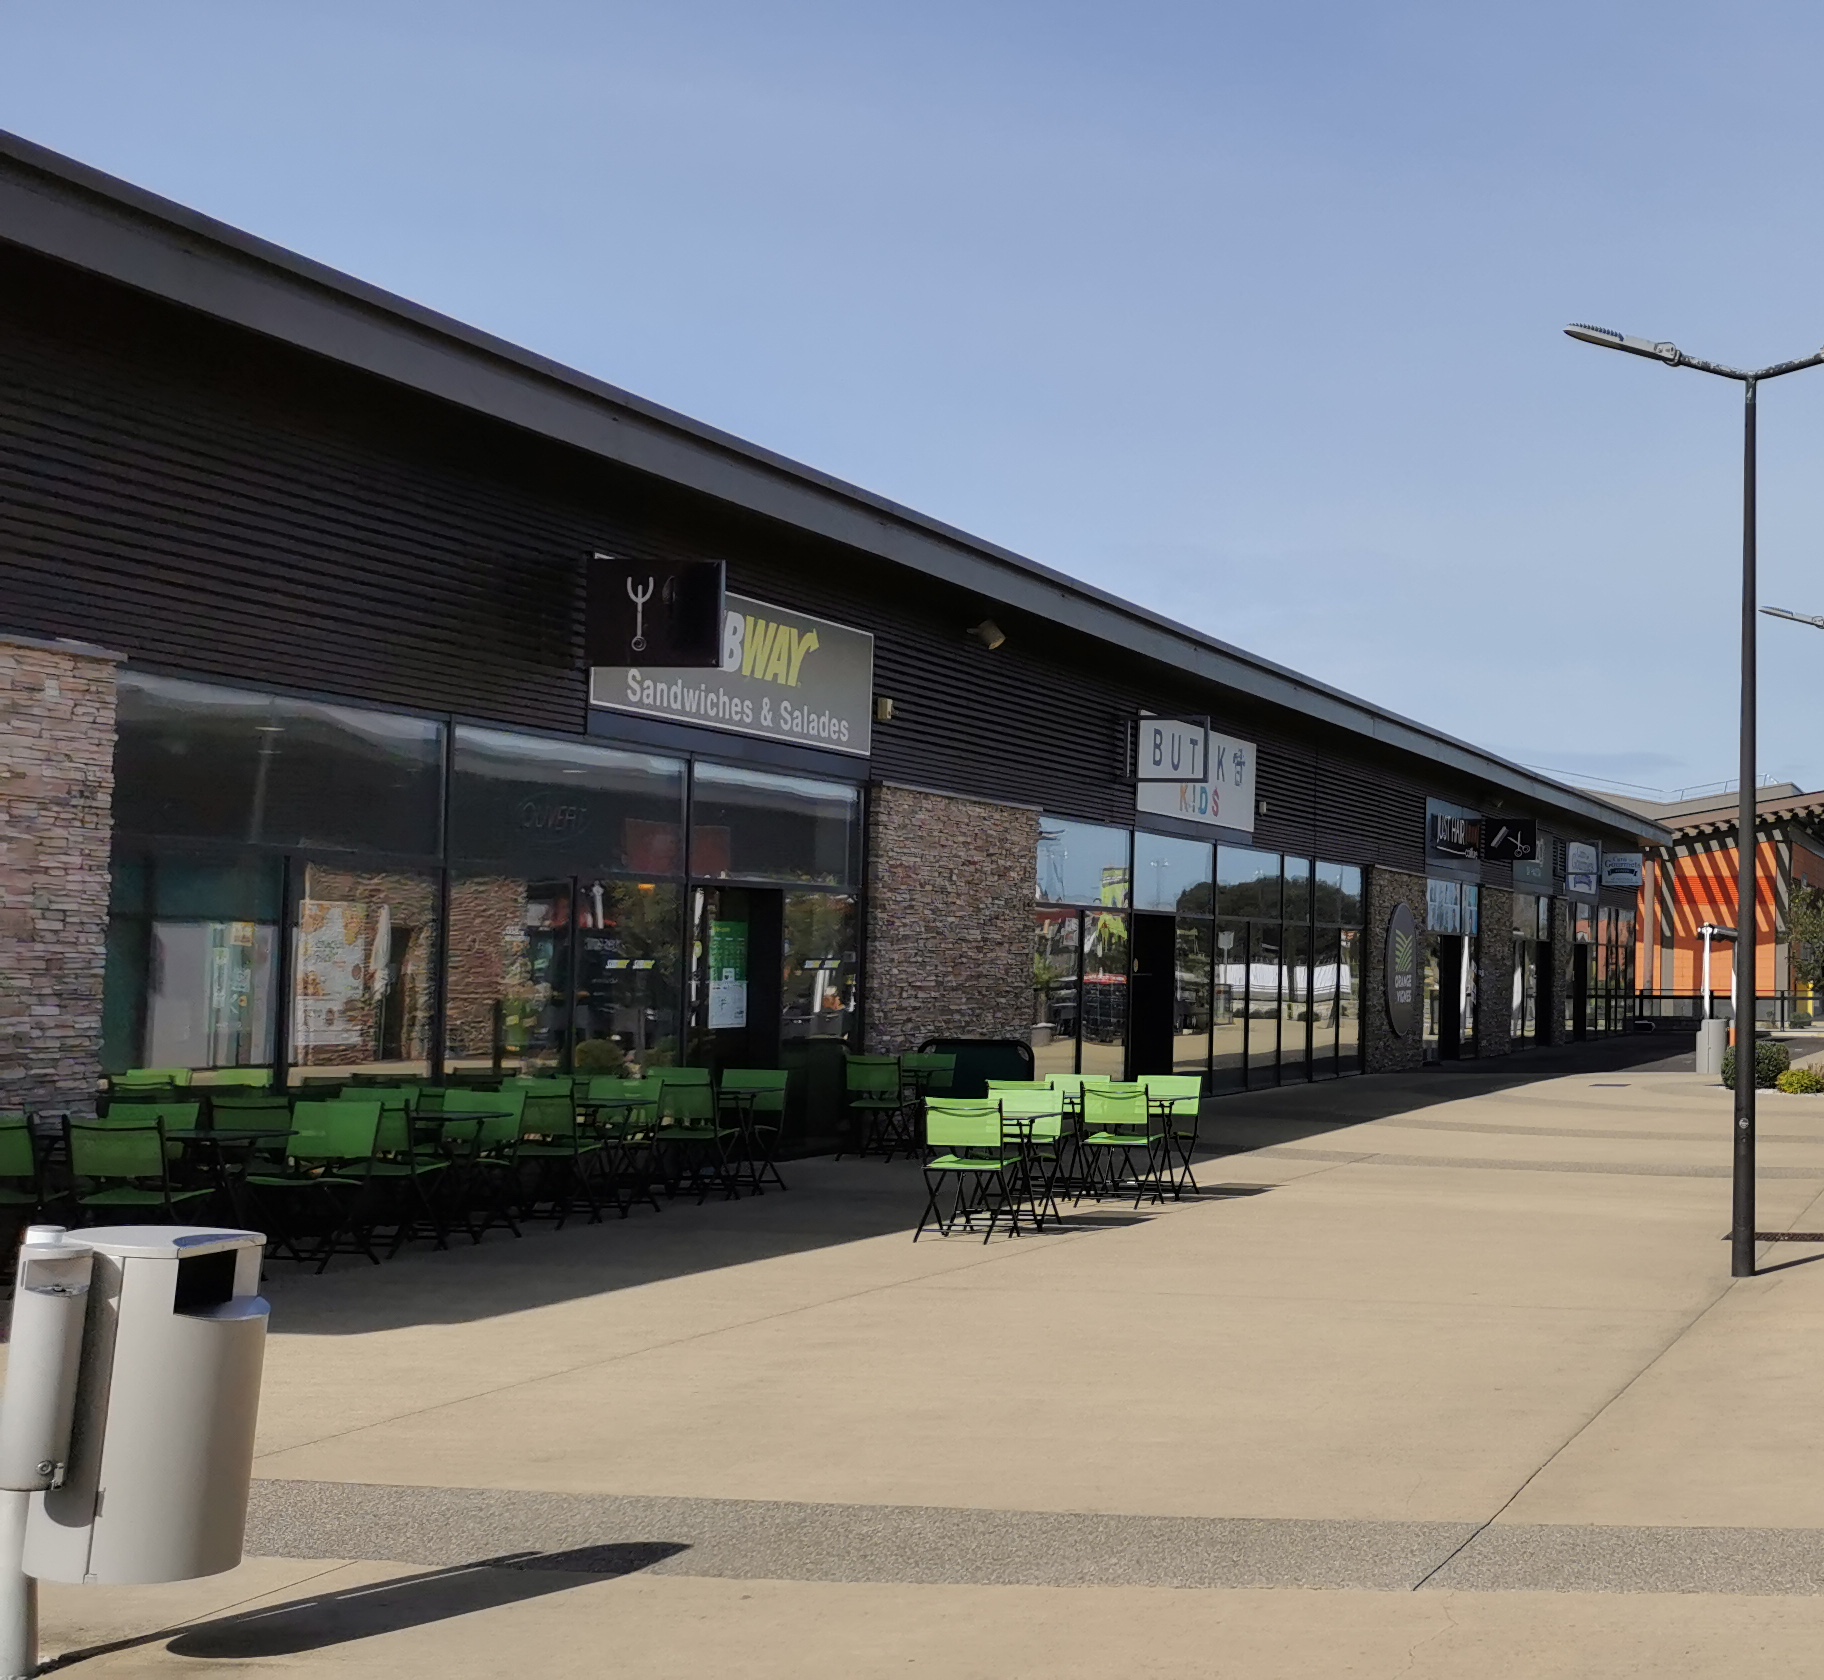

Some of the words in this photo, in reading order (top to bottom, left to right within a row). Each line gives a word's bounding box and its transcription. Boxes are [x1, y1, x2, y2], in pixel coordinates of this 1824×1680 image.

[719, 610, 820, 687] BWAY
[626, 668, 753, 723] Sandwiches
[760, 697, 773, 727] &
[780, 700, 849, 742] Salades
[1437, 813, 1451, 843] JUST
